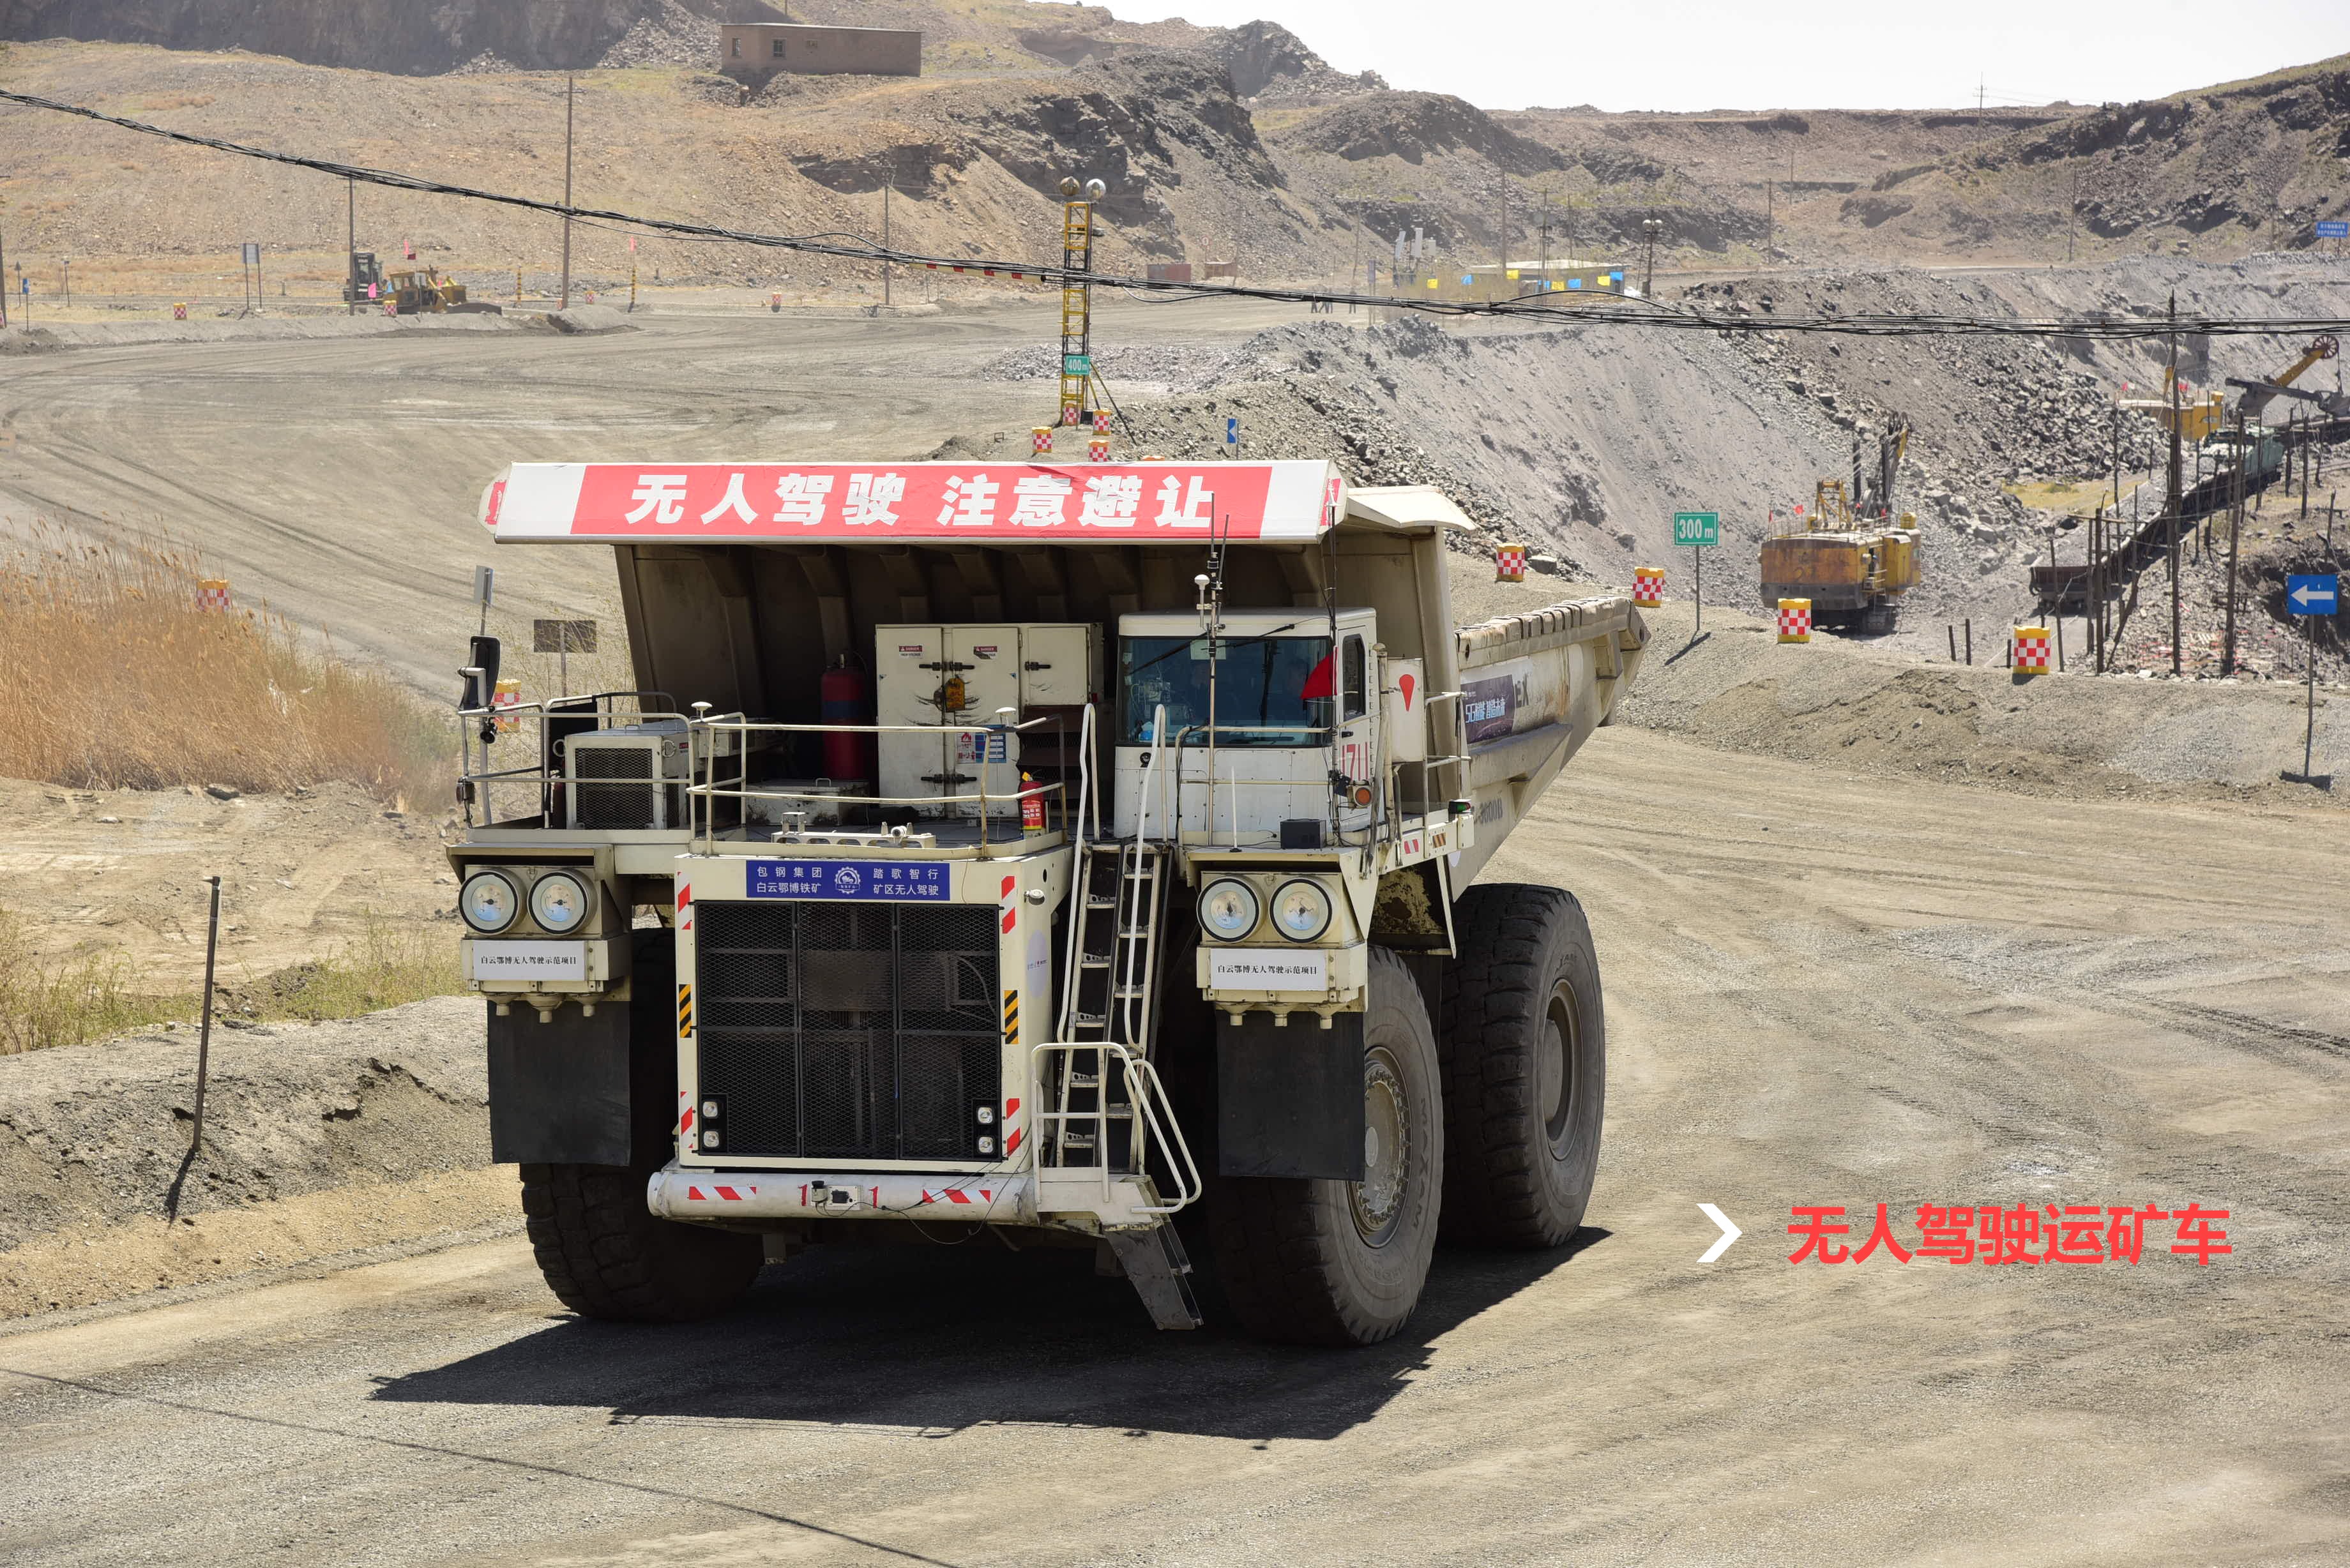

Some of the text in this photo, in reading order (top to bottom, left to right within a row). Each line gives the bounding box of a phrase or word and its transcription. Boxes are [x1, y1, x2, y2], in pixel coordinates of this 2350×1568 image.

[1068, 359, 1082, 371] 400
[624, 472, 1215, 528] 无人驾驶 注意避让
[1678, 518, 1714, 539] 300 m
[757, 866, 939, 880] 包钢集团 踏歌智行
[757, 882, 939, 896] 白云鄂博铁矿 矿区无人驾驶
